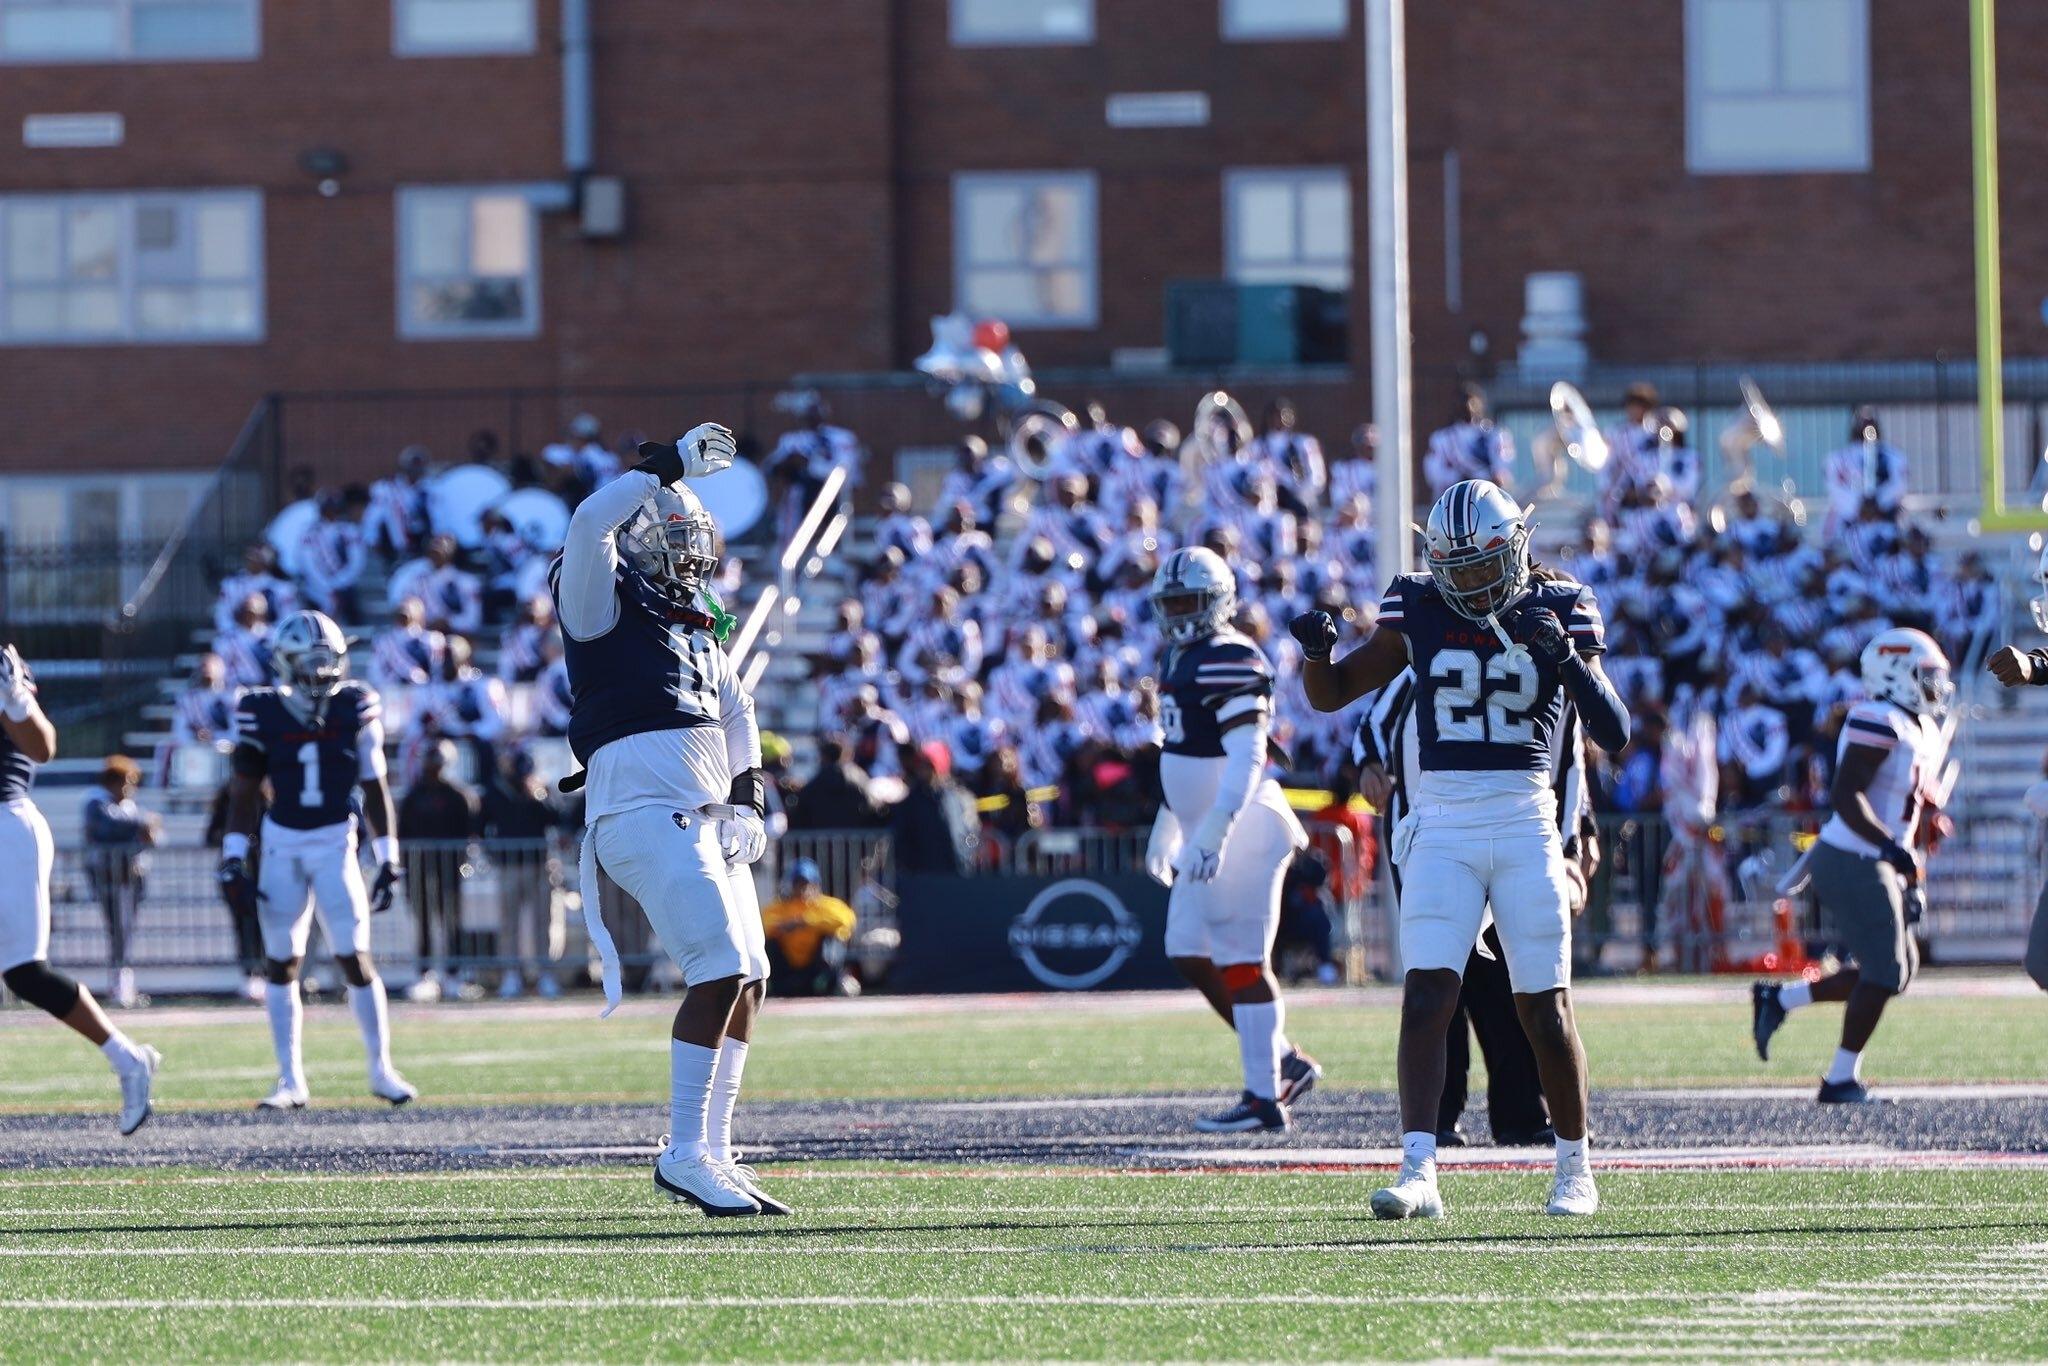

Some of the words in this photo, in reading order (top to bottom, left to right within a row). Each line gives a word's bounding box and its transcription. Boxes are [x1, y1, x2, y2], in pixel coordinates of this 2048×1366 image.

[1444, 631, 1523, 647] HOWA
[1429, 649, 1540, 743] 22
[298, 742, 323, 806] 1
[1008, 924, 1142, 948] NISSAN
